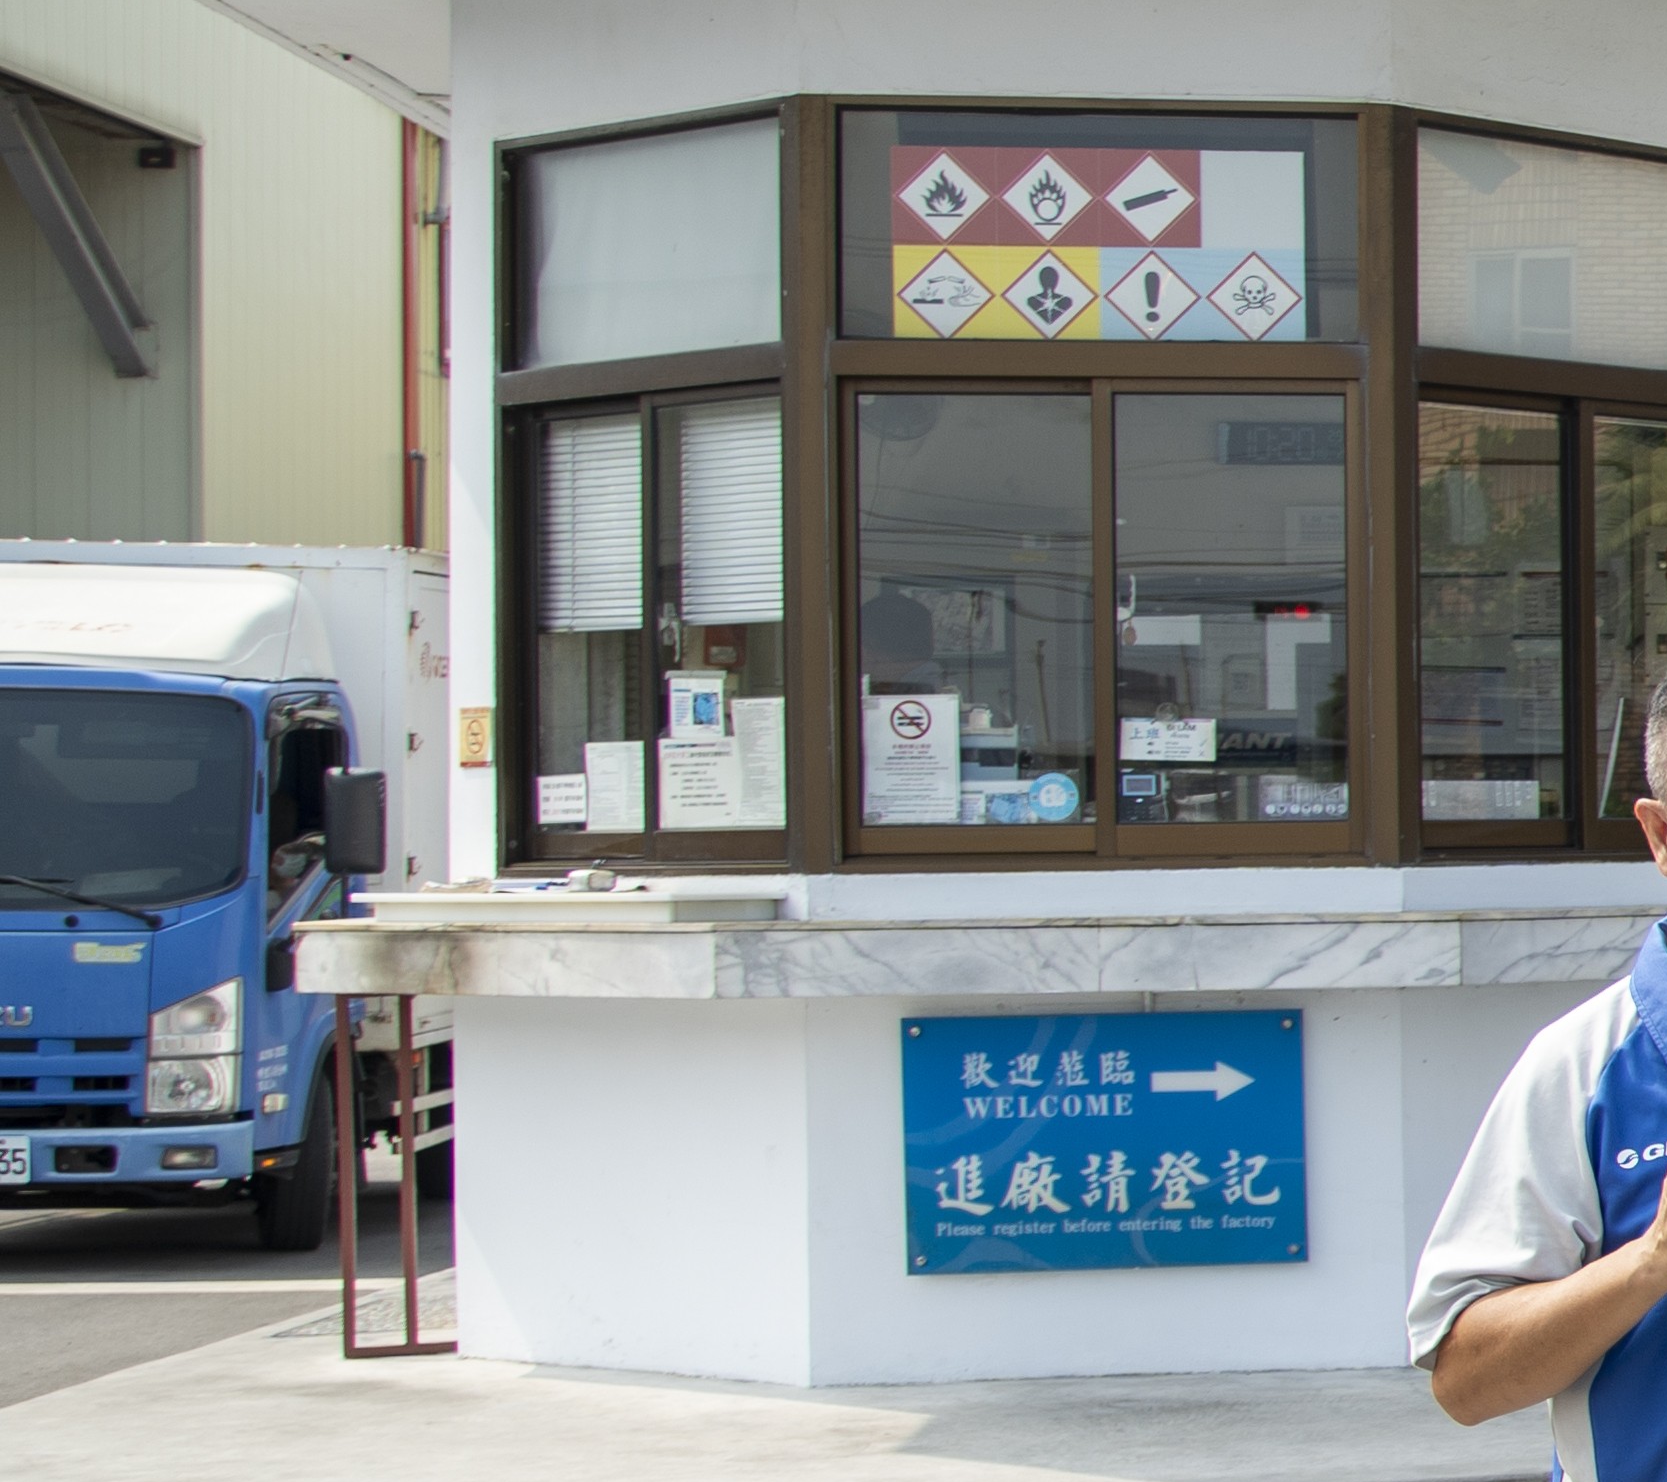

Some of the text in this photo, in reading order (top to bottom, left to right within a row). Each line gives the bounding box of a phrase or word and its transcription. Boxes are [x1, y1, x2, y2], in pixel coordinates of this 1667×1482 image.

[962, 1093, 1134, 1119] WELCOME
[935, 1149, 1282, 1216] 進廠請登記
[936, 1215, 1276, 1237] Please register before entering the factory
